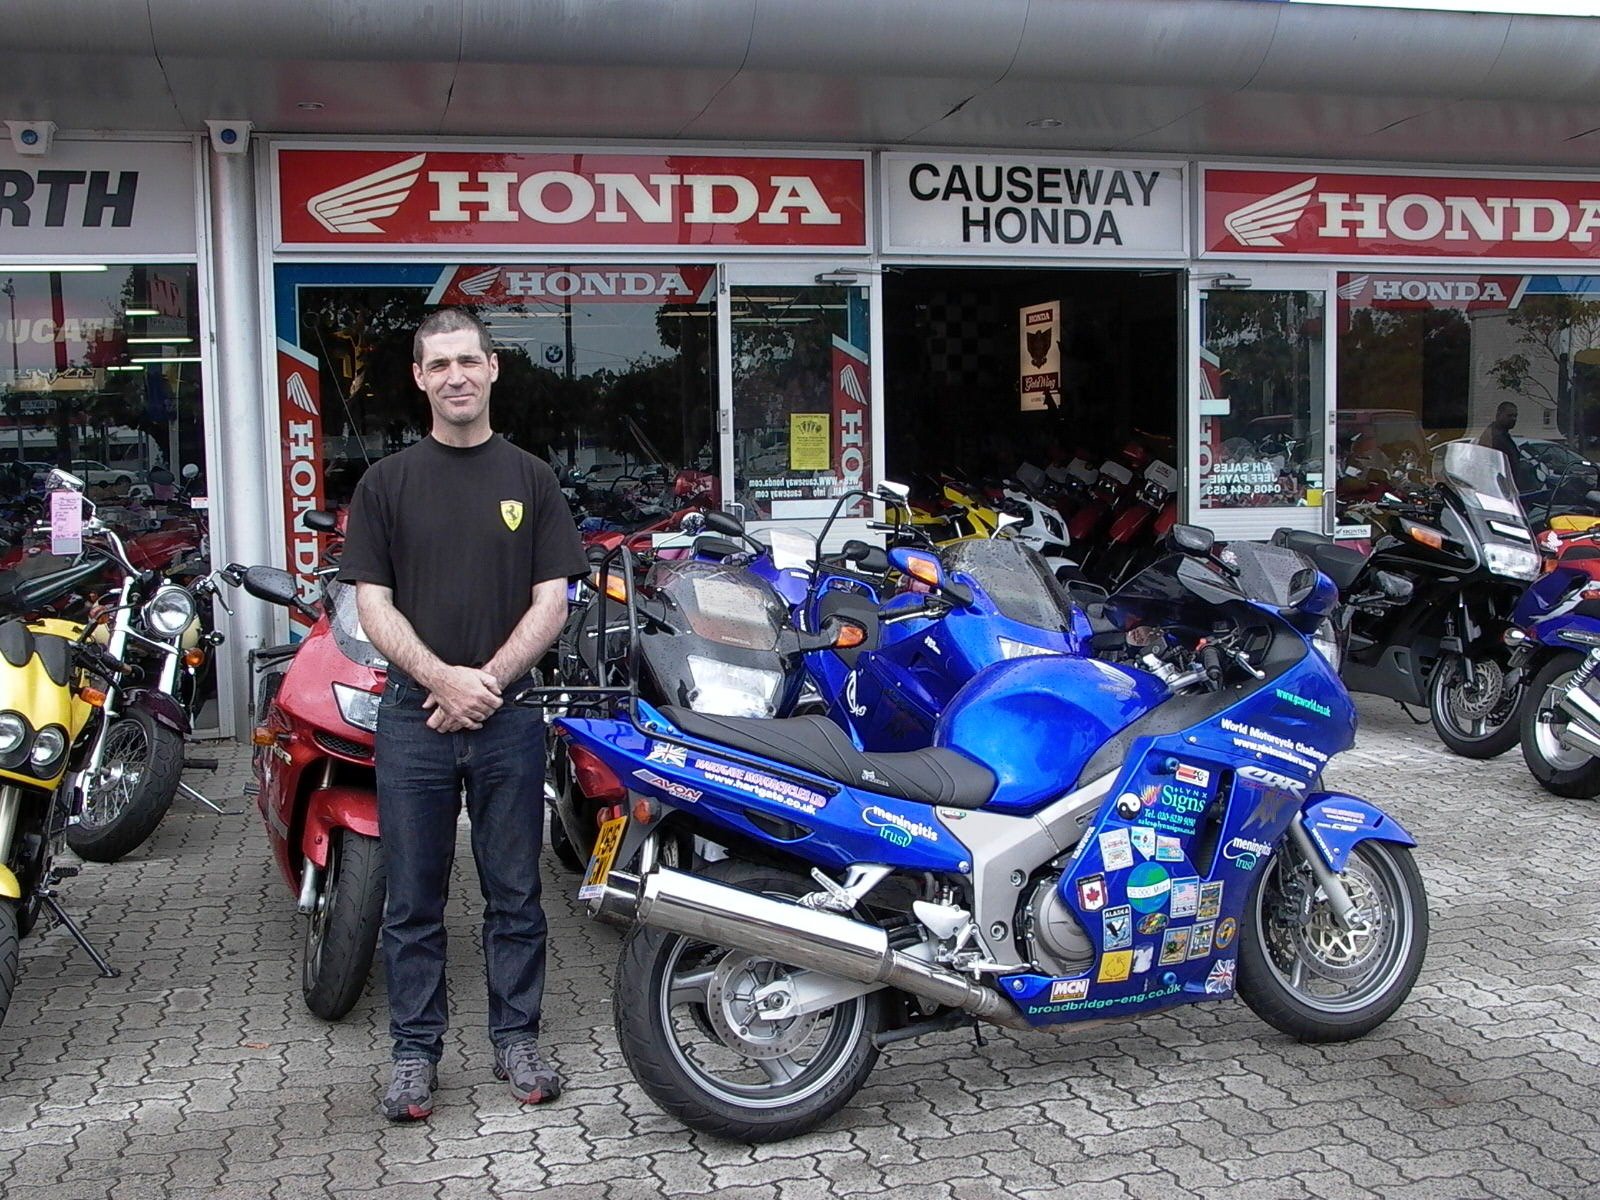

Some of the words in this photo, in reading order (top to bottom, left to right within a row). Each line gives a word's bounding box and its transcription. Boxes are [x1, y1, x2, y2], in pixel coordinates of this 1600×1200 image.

[428, 170, 842, 225] HONDA
[909, 163, 1161, 206] CAUSEWAY
[962, 206, 1123, 246] HONDA
[505, 271, 693, 297] HONDA
[1372, 279, 1507, 301] HONDA
[1028, 312, 1050, 323] HONDA
[288, 420, 322, 614] HONDA
[1221, 717, 1248, 735] World
[1249, 726, 1295, 750] Motorcycle
[652, 776, 701, 798] AVON
[1161, 784, 1206, 813] Signs
[872, 806, 938, 842] meningitis
[880, 826, 909, 847] trust
[1232, 836, 1272, 858] meningitis
[1235, 856, 1255, 871] trust
[1104, 907, 1130, 918] ALASKA
[1028, 984, 1182, 1015] broadbridge-eng.co.uk
[1054, 980, 1085, 995] MCN
